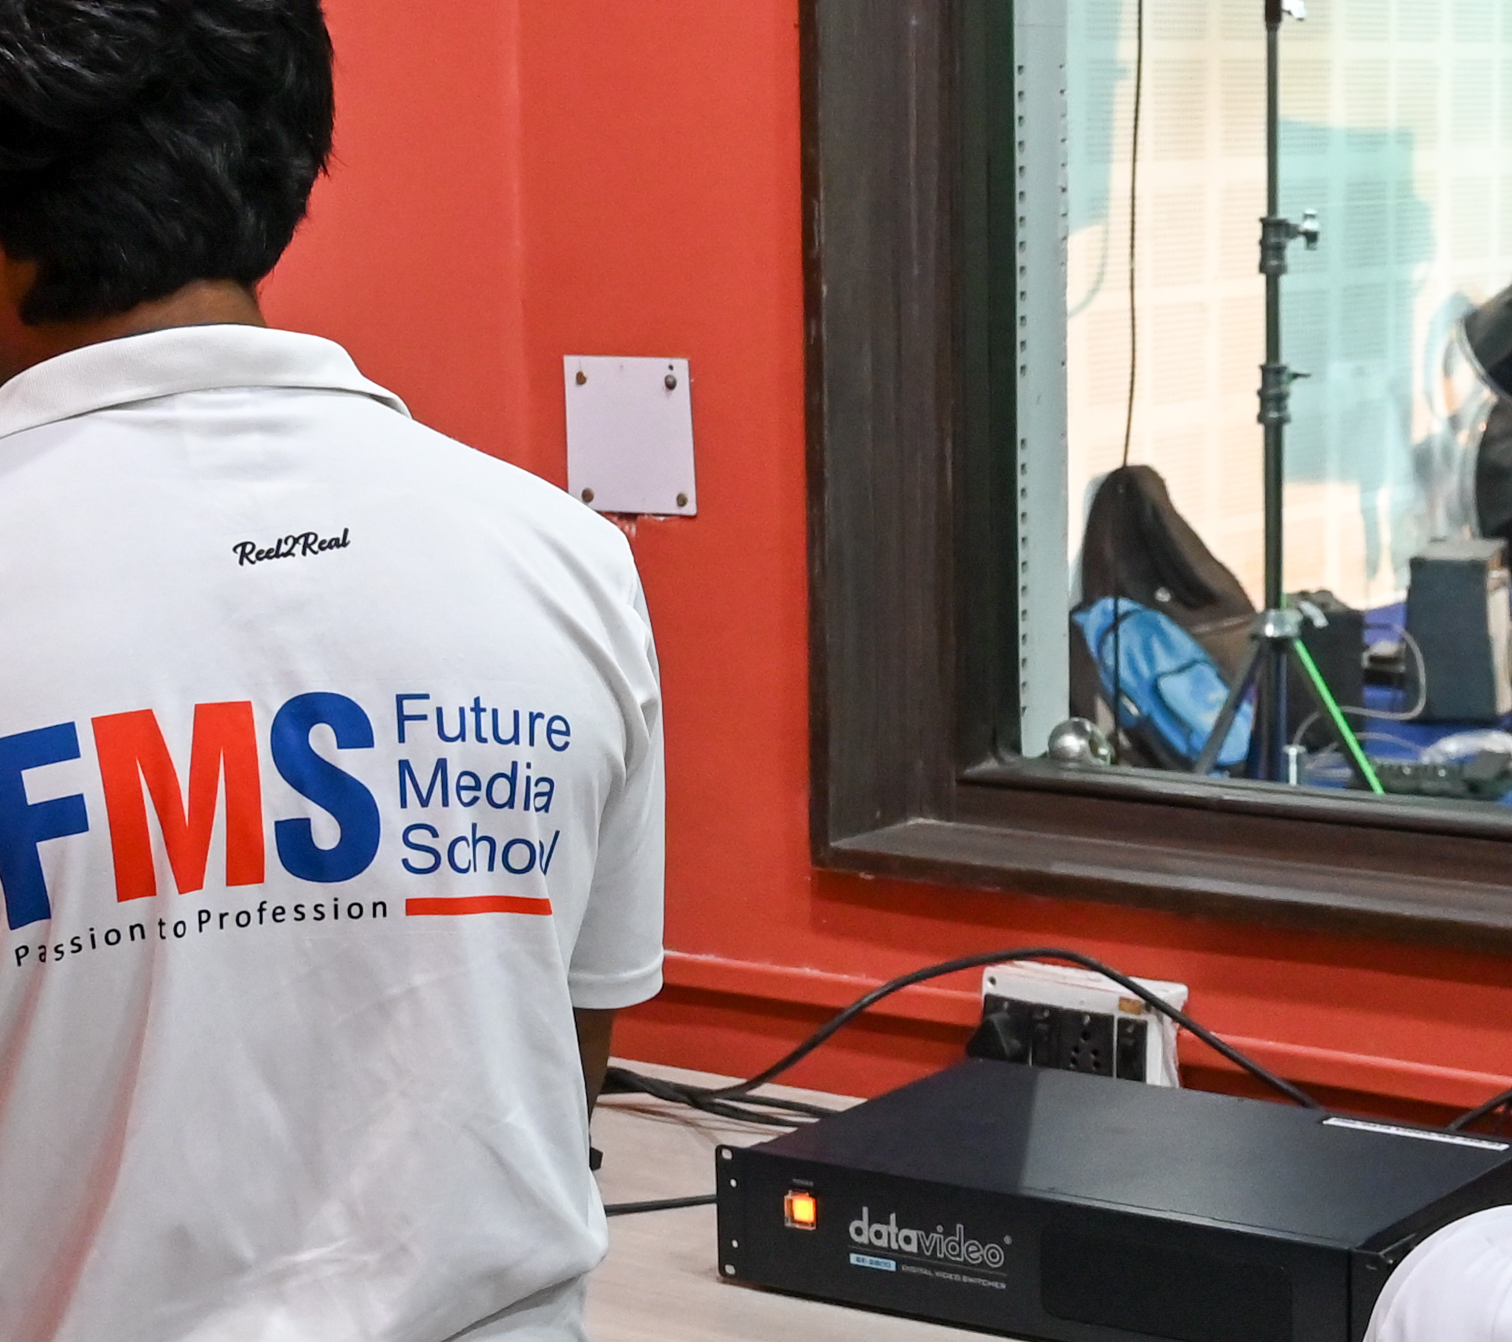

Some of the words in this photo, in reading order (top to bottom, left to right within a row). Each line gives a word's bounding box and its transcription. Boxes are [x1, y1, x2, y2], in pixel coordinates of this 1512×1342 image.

[232, 527, 351, 567] Reel2Real
[395, 693, 572, 752] Future
[398, 757, 555, 814] Media
[14, 920, 147, 967] Passion
[157, 917, 188, 941] to
[197, 897, 388, 934] Profession
[848, 1205, 1005, 1268] datavideo
